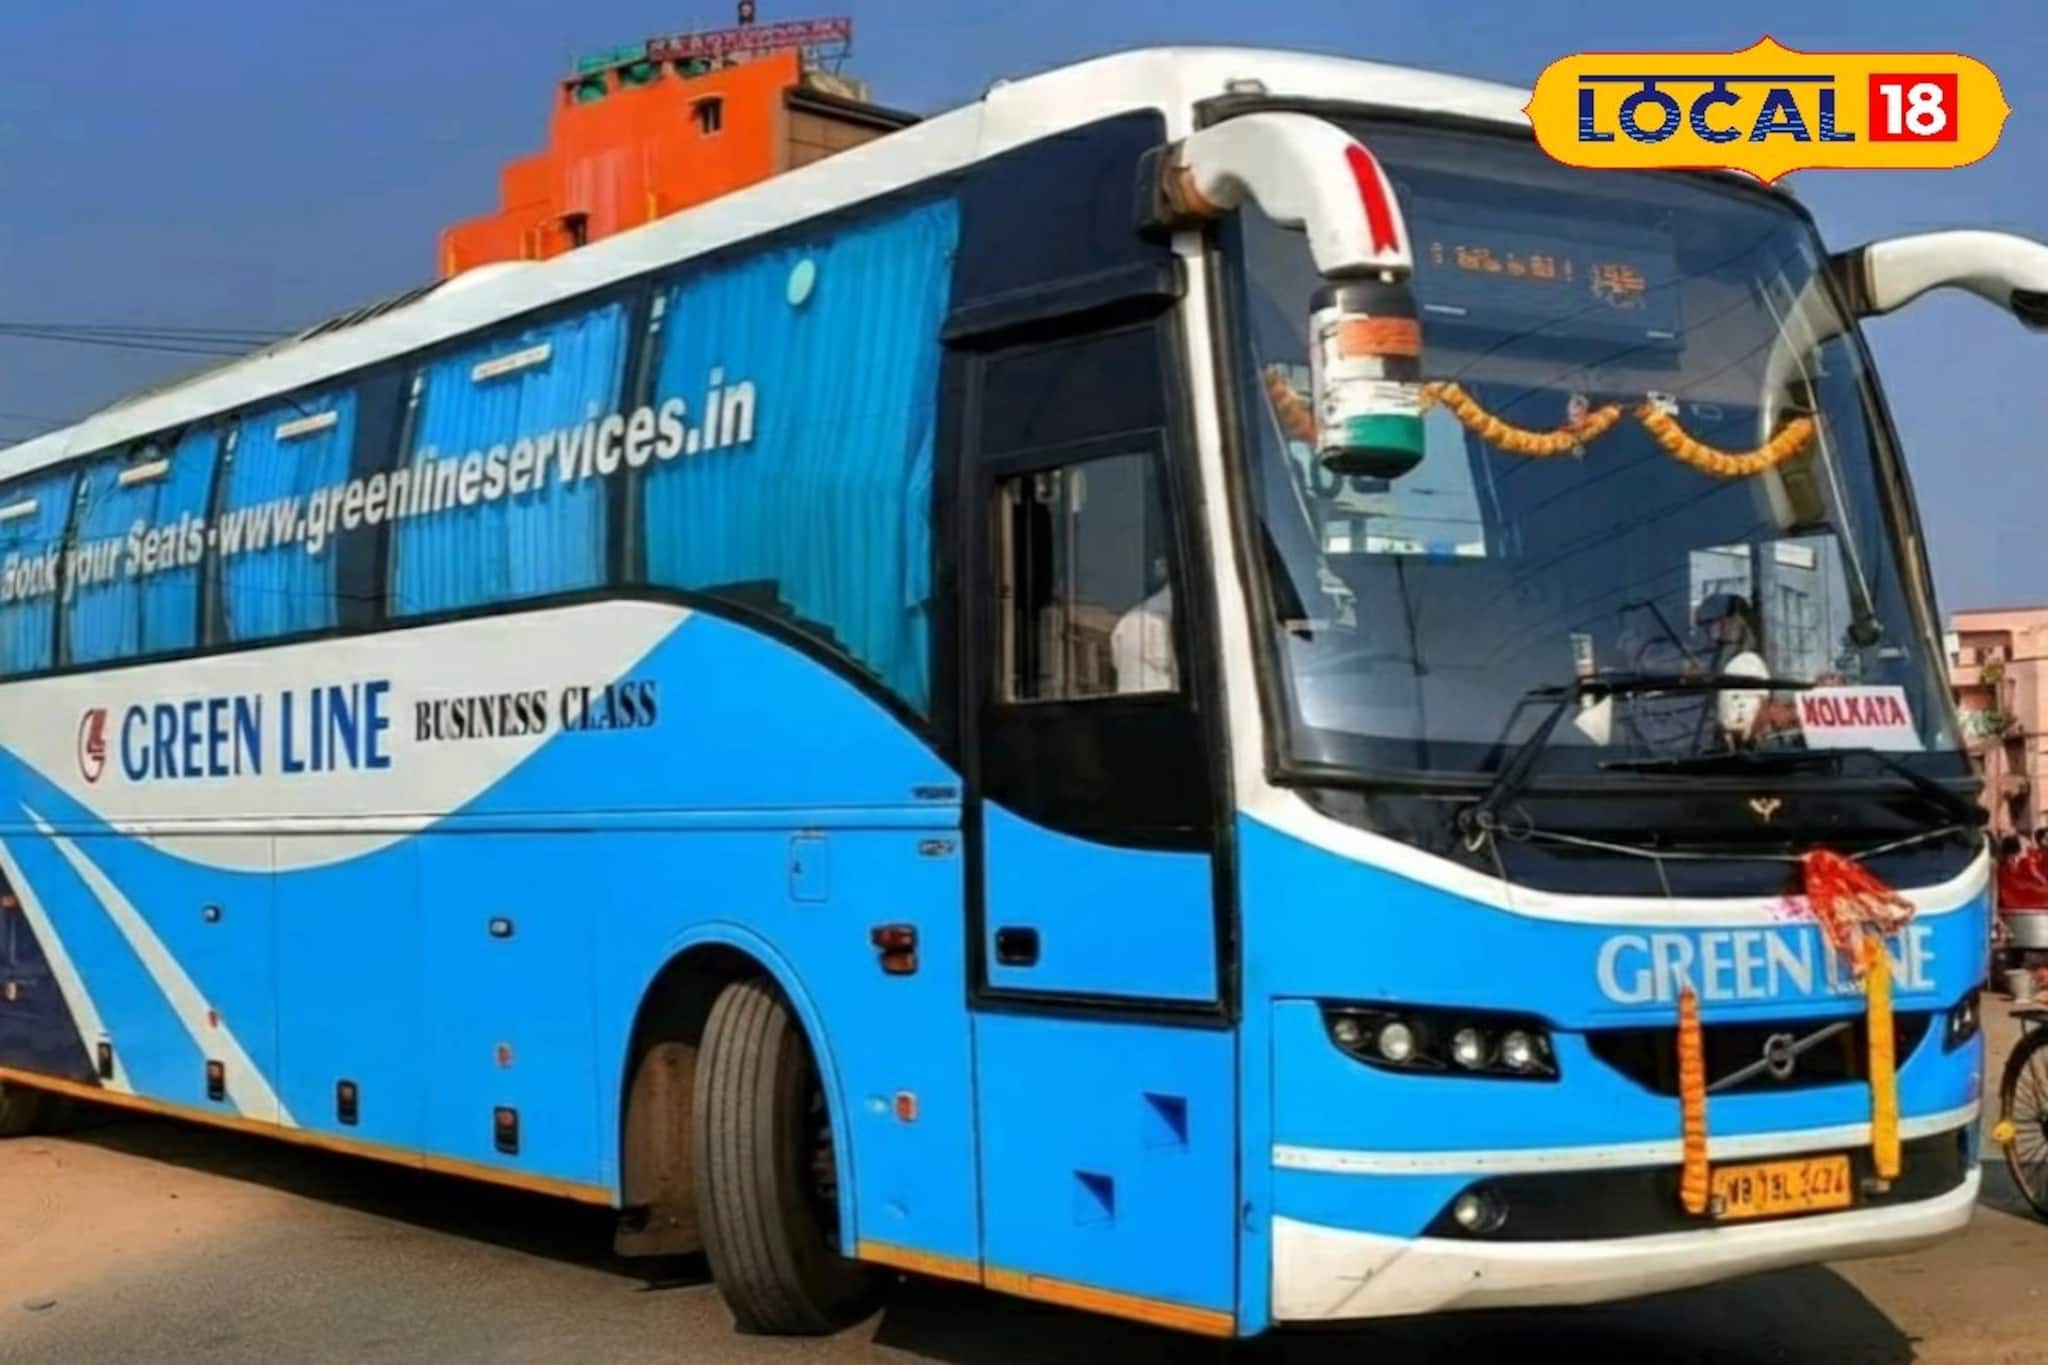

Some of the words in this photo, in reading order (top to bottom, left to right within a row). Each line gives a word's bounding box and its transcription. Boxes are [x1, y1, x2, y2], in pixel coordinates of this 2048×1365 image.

[61, 535, 124, 604] your
[123, 510, 206, 577] Seats
[121, 694, 263, 782] GREEN
[281, 678, 392, 774] LINE
[414, 689, 548, 742] BUSINESS
[560, 679, 658, 732] CLASS
[1801, 695, 1906, 726] KOLKATA
[1596, 927, 1814, 1005] GREEN
